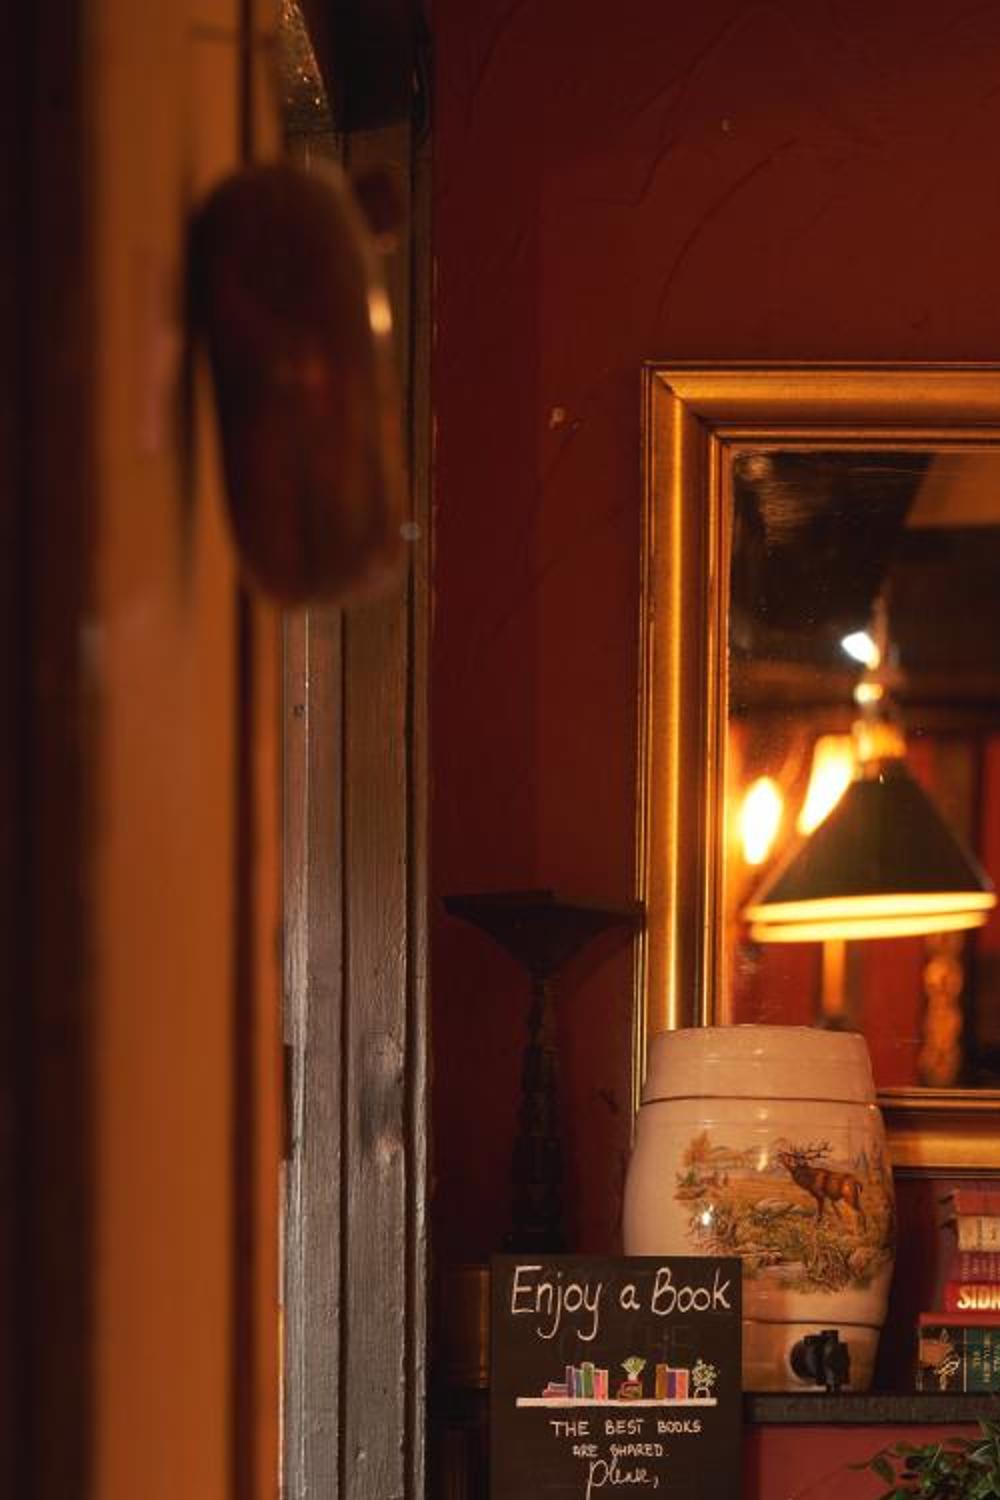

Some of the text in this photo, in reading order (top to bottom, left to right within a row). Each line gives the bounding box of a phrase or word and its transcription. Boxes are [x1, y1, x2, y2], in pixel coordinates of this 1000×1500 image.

[511, 1265, 731, 1341] Enjoy a Book
[550, 1419, 701, 1437] THE BEST BOOKS
[573, 1444, 664, 1457] ARE SHARED
